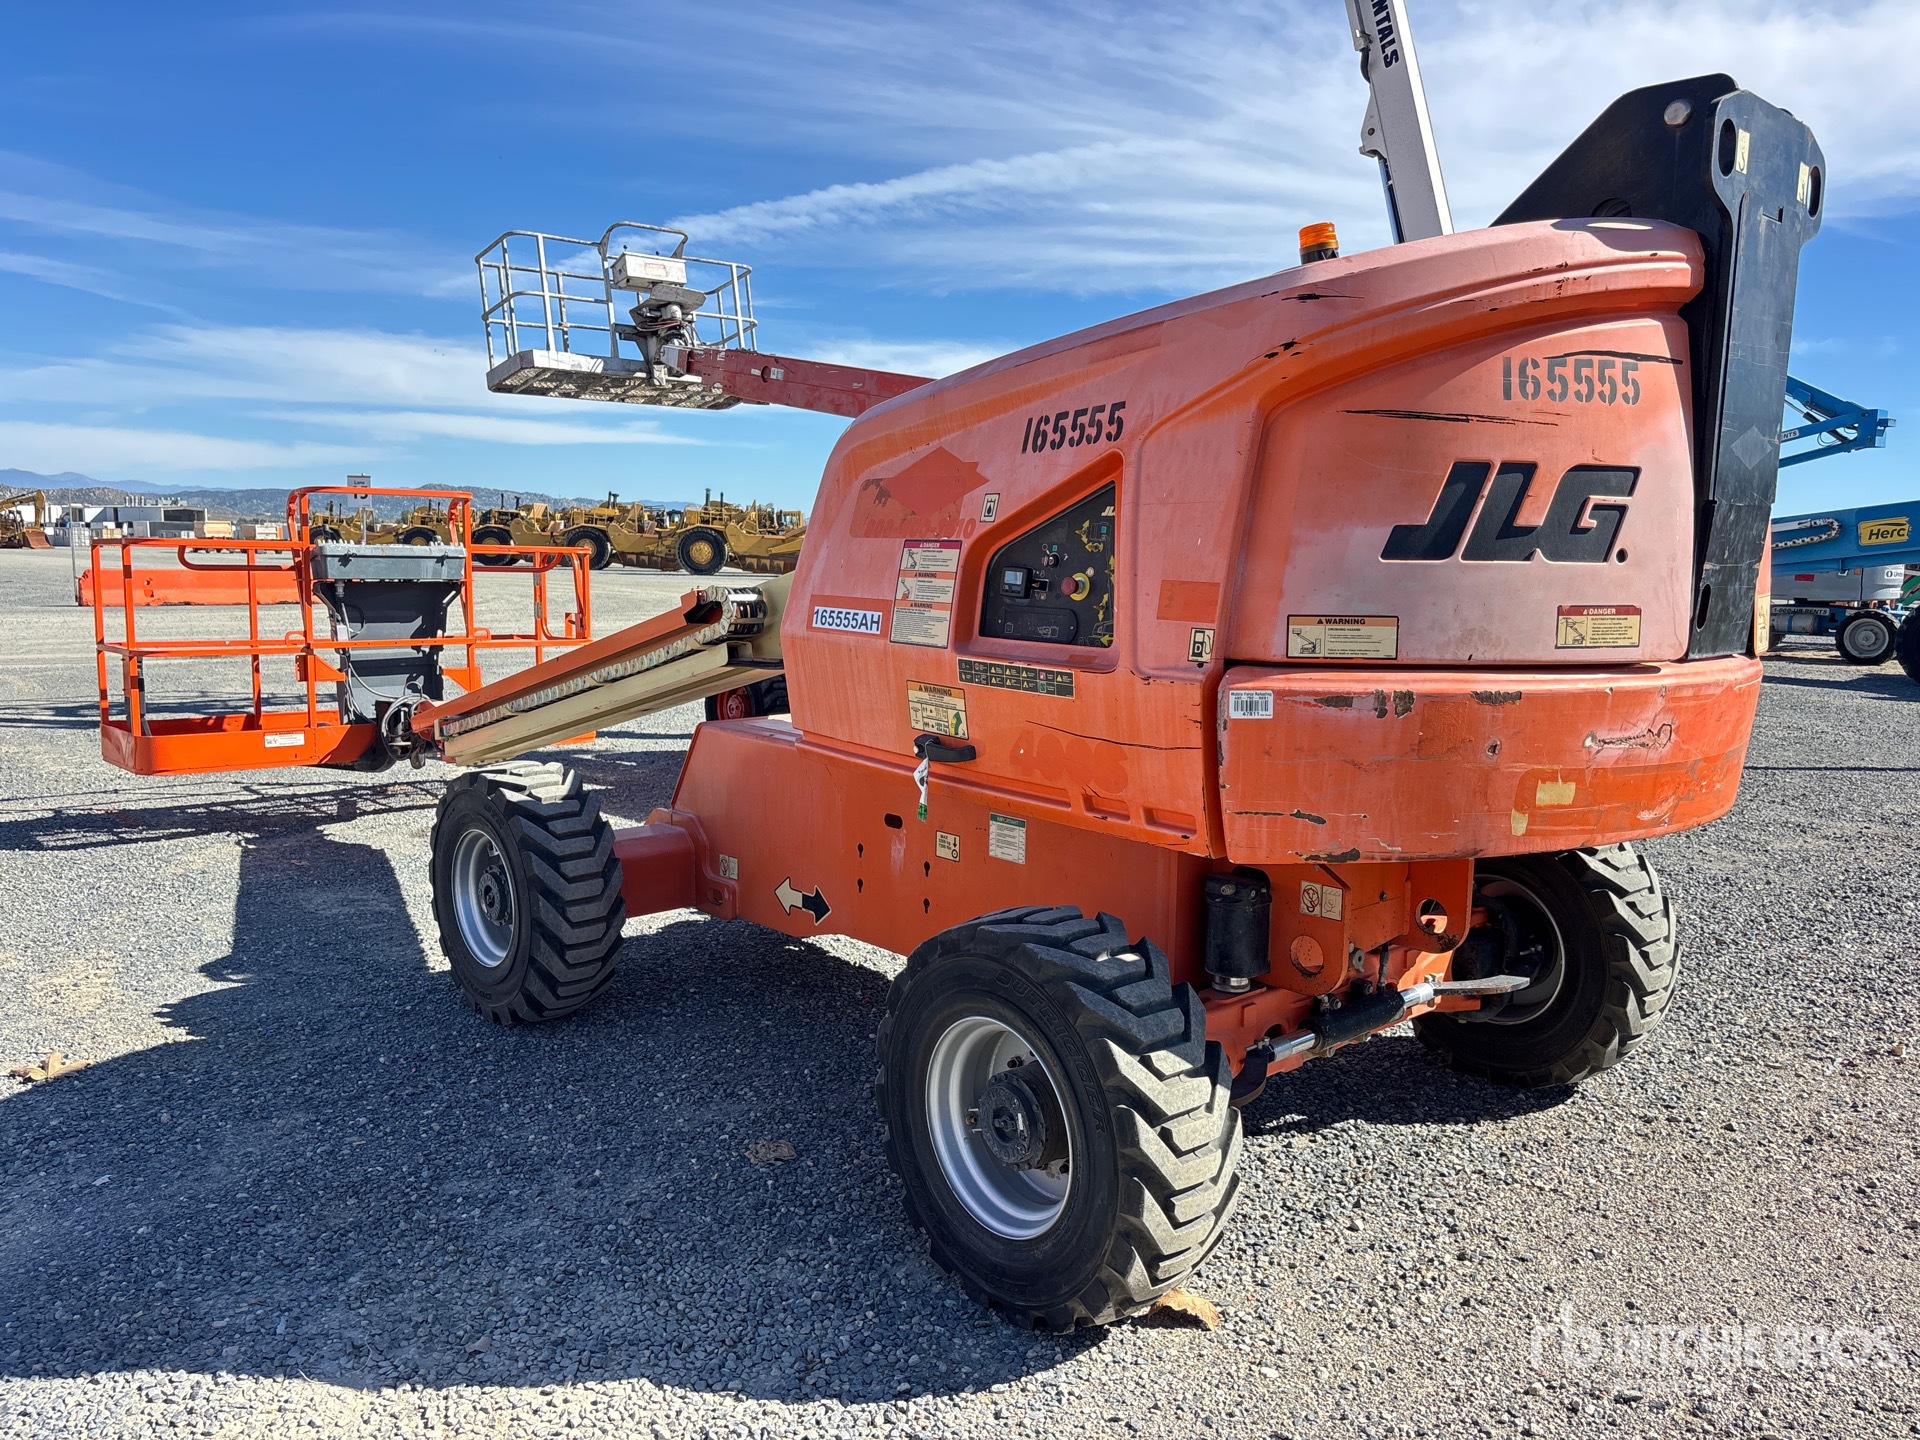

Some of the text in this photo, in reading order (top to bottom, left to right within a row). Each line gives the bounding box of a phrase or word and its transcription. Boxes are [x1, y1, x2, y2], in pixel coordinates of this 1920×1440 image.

[1371, 0, 1399, 68] NTALS
[1502, 357, 1640, 405] 165555
[1021, 401, 1126, 454] 165555
[1101, 505, 1116, 516] JL
[1868, 528, 1906, 540] Herc
[814, 608, 881, 632] 165555AH
[1194, 643, 1202, 653] D
[923, 685, 952, 696] WARNING
[995, 969, 1106, 1137] OUTRIGGER
